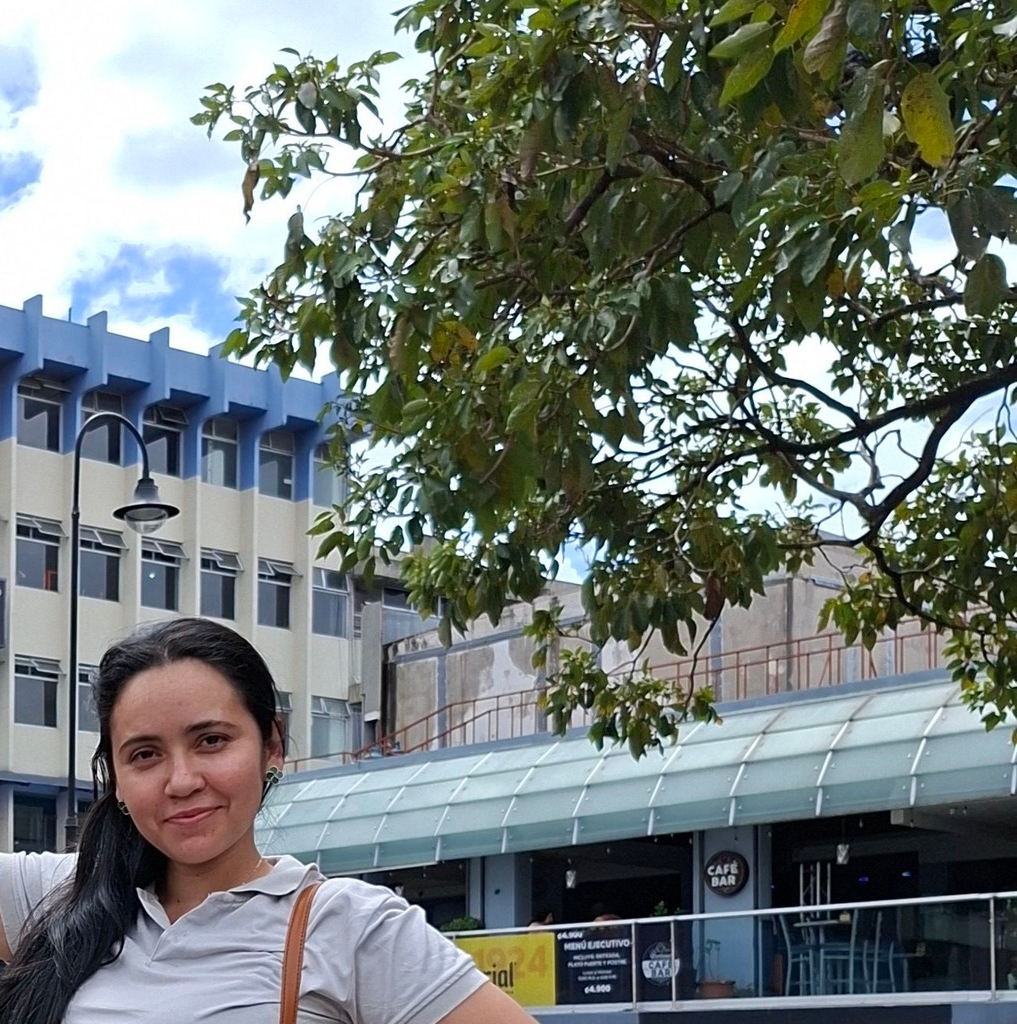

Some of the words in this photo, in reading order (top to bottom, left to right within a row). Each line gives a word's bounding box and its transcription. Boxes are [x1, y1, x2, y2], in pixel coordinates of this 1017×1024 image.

[707, 860, 738, 876] CAFÉ
[711, 875, 736, 887] BAR
[564, 940, 587, 951] MENÚ
[588, 939, 630, 950] EJECUTIVO
